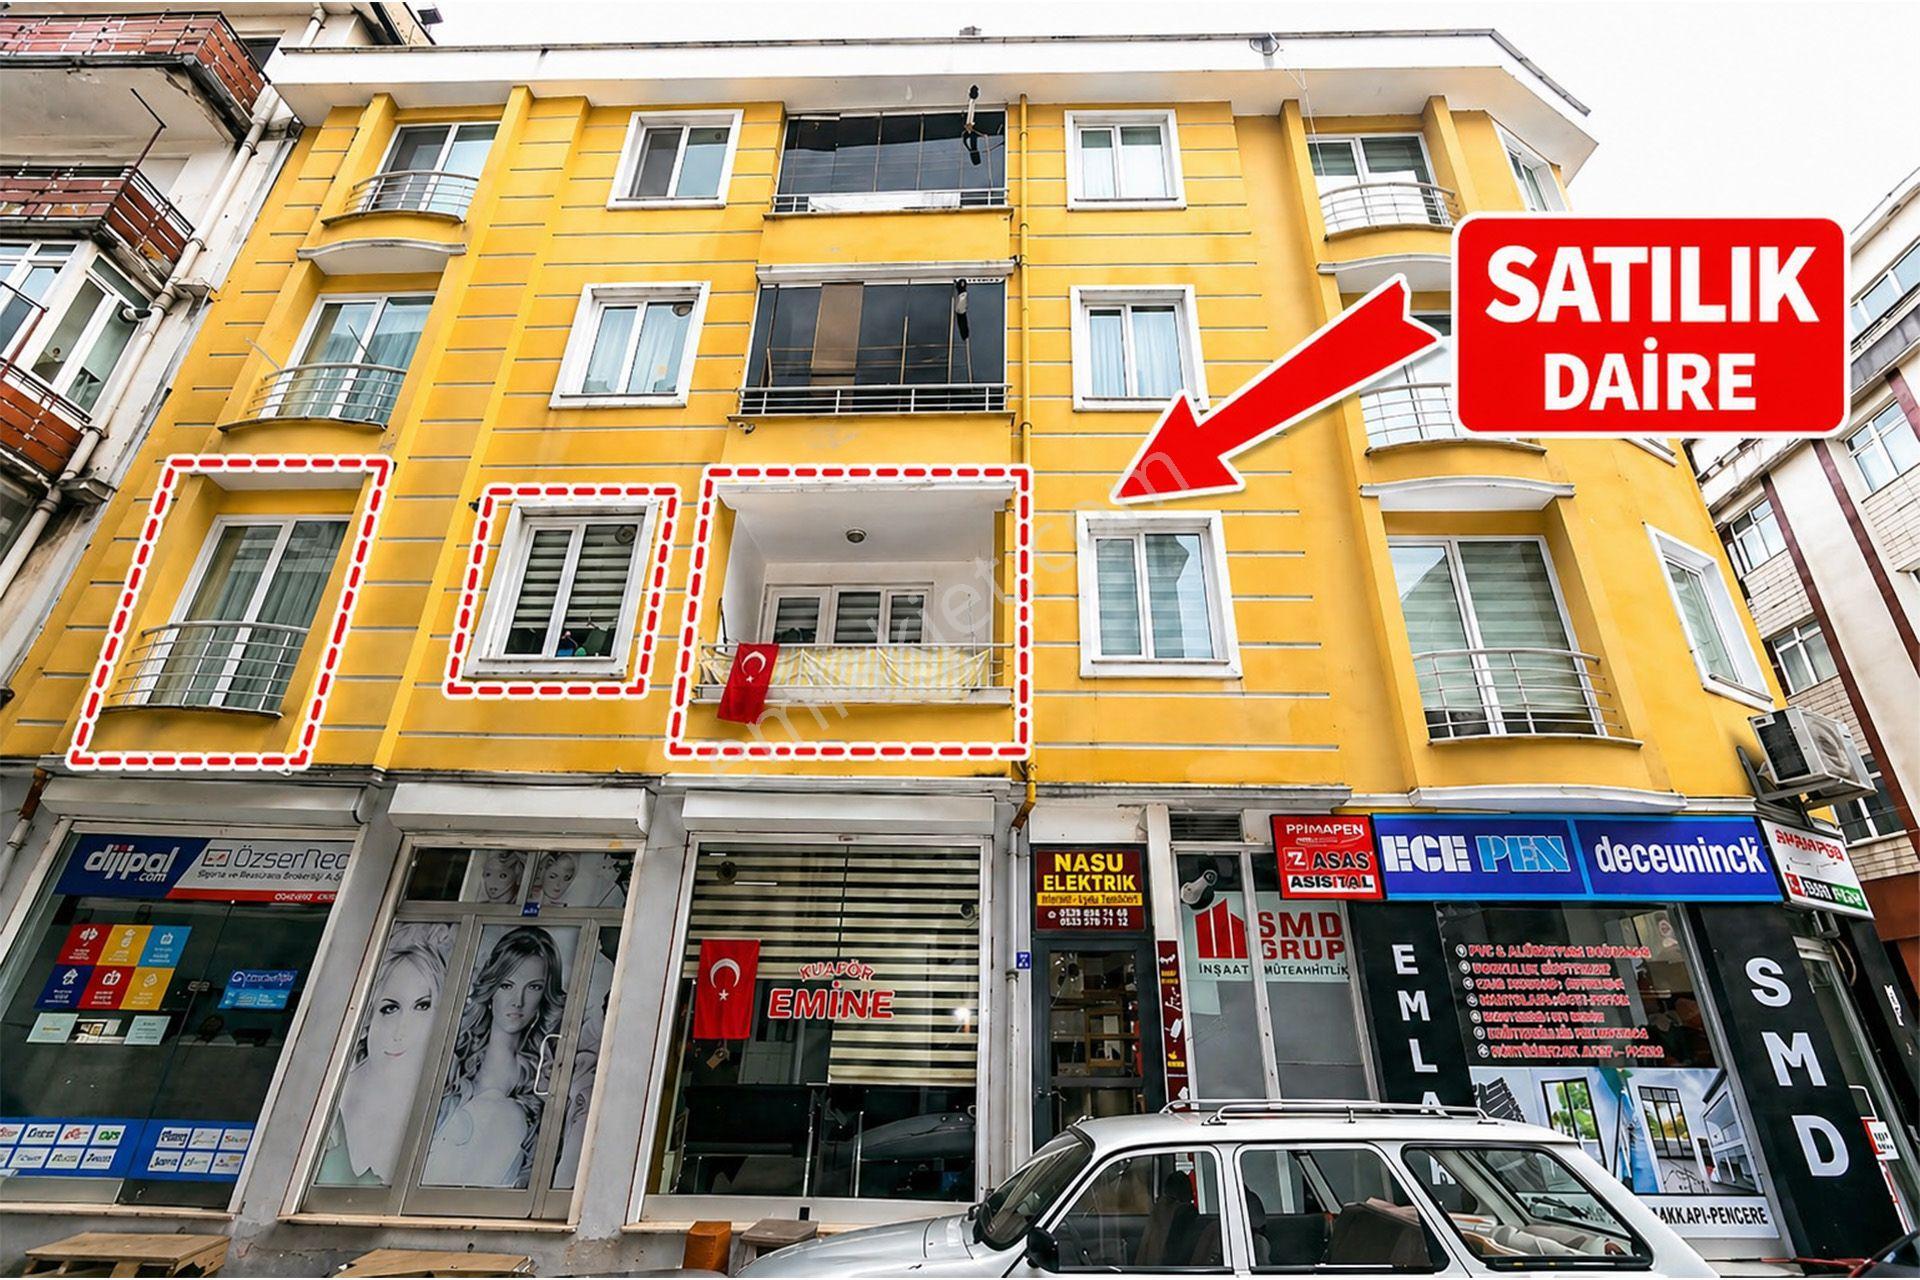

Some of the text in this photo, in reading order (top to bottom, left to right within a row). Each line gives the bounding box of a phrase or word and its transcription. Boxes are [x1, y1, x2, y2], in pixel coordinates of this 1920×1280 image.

[84, 844, 180, 880] dijipal
[1054, 853, 1123, 873] NASU
[1380, 835, 1571, 872] ECE PEN
[1594, 835, 1767, 874] deceuninck
[1258, 912, 1343, 937] SMD
[1262, 940, 1345, 960] GRUP
[768, 980, 896, 1020] EMİNE
[1745, 957, 1849, 1177] SMD
